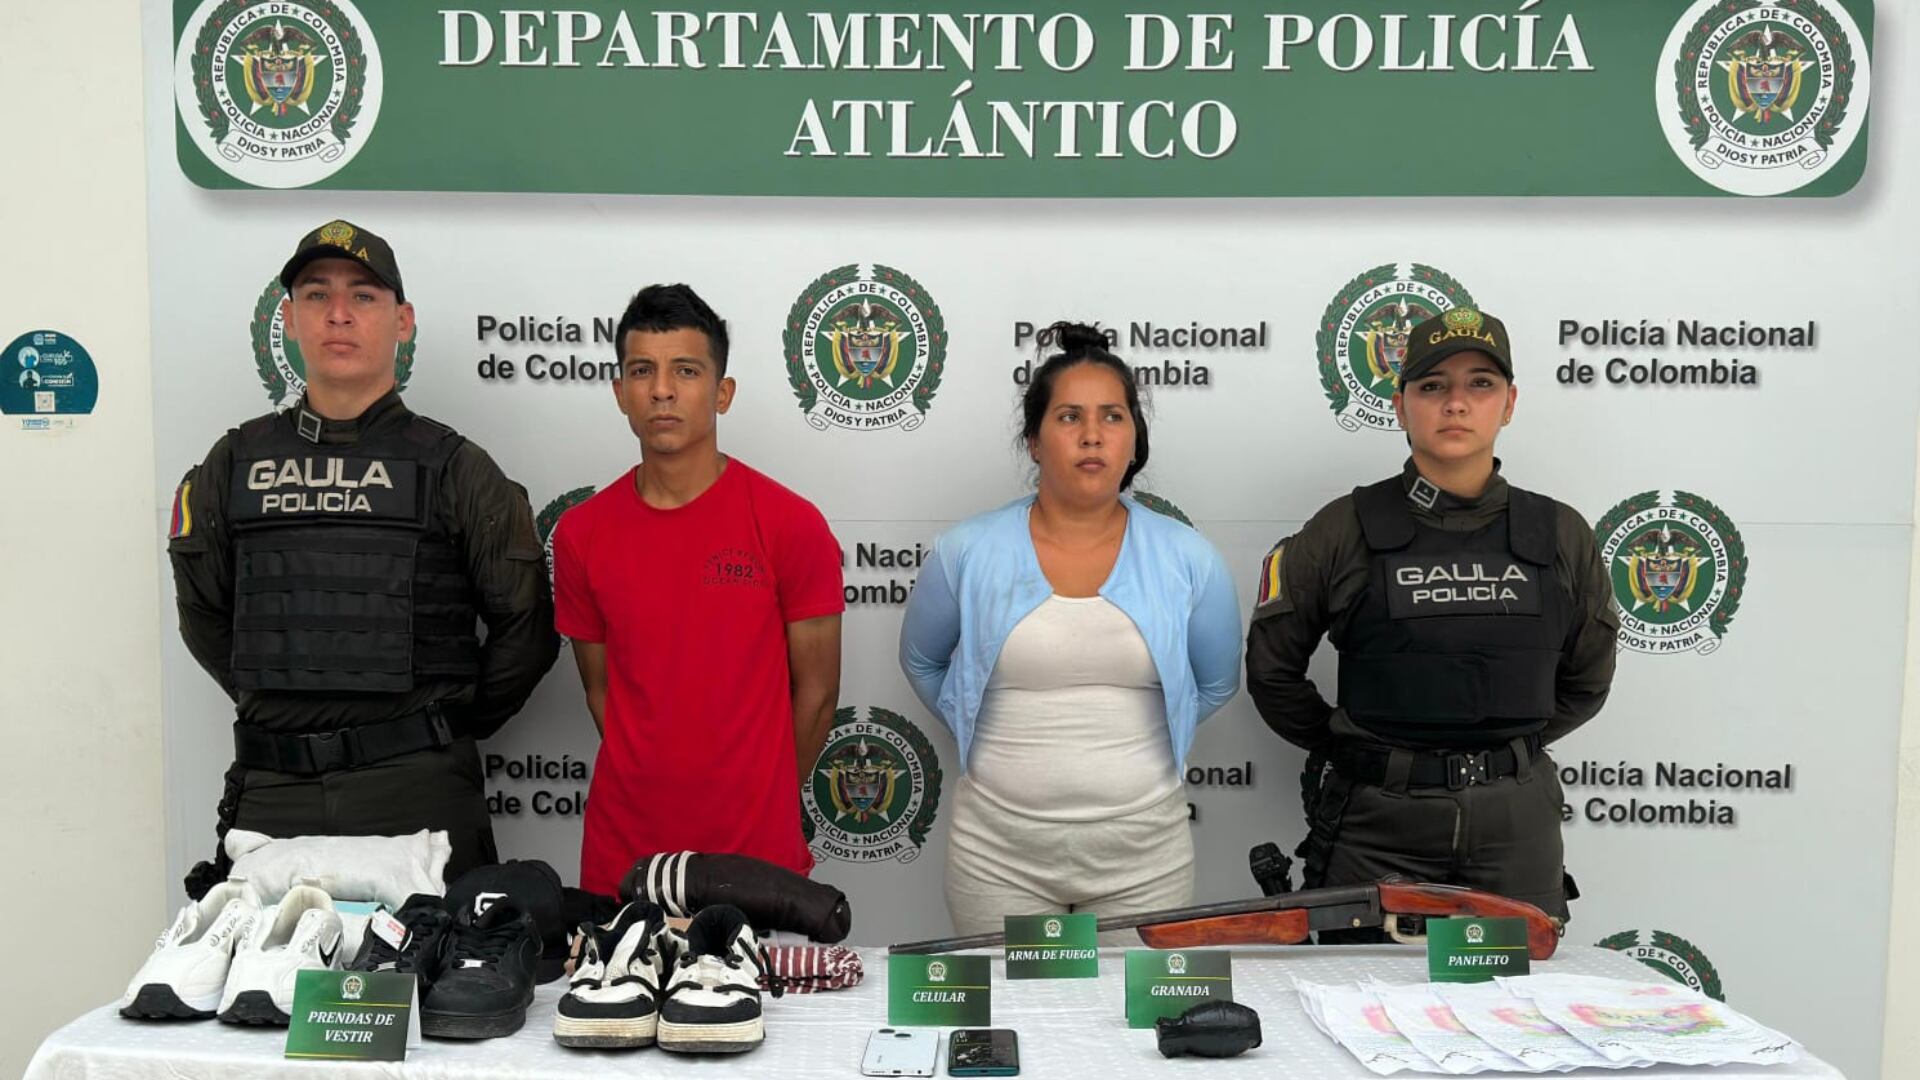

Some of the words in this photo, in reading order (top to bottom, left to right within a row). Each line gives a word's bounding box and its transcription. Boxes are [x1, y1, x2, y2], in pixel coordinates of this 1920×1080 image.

[270, 4, 289, 14] DE
[303, 12, 345, 83] COLOMBIA
[438, 10, 1095, 71] DEPARTAMENTO
[1124, 13, 1234, 71] DE
[1262, 0, 1595, 72] POLICÍA
[1760, 9, 1779, 20] DE
[1793, 17, 1832, 89] COLOMBIA
[281, 99, 340, 140] NACIONAL
[784, 79, 1238, 158] ATLÁNTICO
[1762, 104, 1825, 147] NACIONAL
[281, 137, 326, 158] PATRIA
[1761, 145, 1808, 165] PATRIA
[1396, 282, 1414, 293] DE
[477, 315, 581, 342] Policía
[859, 283, 877, 293] DE
[889, 291, 927, 358] COLOMBIA
[1558, 319, 1665, 346] Policía
[1677, 319, 1815, 347] Nacional
[1130, 321, 1267, 348] Nacional
[1429, 327, 1497, 347] GAULA
[478, 354, 515, 379] de
[525, 354, 622, 381] Colom
[1133, 359, 1209, 386] mbia
[1556, 358, 1594, 384] de
[1605, 357, 1757, 384] Colombia
[865, 372, 921, 411] NACIONAL
[865, 408, 907, 427] PATRIA
[246, 457, 394, 490] GAULA
[261, 489, 372, 514] POLICÍA
[856, 543, 929, 567] Naci
[1659, 509, 1677, 519] DE
[1689, 516, 1726, 582] COLOMBIA
[716, 562, 753, 579] 1982
[1396, 563, 1528, 585] GAULA
[1412, 583, 1518, 604] POLICÍA
[1661, 596, 1720, 635] NACIONAL
[1660, 632, 1703, 650] PATRIA
[485, 754, 587, 779] Policía
[856, 724, 873, 734] DE
[885, 731, 922, 794] COLOMBIA
[1186, 761, 1251, 786] onal
[1553, 760, 1643, 786] olicía
[1655, 762, 1791, 788] Nacional
[486, 790, 522, 815] de
[1584, 797, 1734, 824] Colombia
[862, 807, 917, 844] NACIONAL
[862, 841, 903, 859] PATRIA
[1007, 950, 1040, 960] ARMA
[1042, 950, 1058, 960] DE
[1059, 949, 1096, 959] FUEGO
[1448, 955, 1509, 966] PANFLETO
[1637, 948, 1656, 957] DE
[912, 991, 966, 1003] CELULAR
[1151, 985, 1210, 996] GRANADA
[307, 1011, 373, 1025] PRENDAS
[374, 1013, 396, 1026] DE
[325, 1029, 373, 1043] VESTIR
